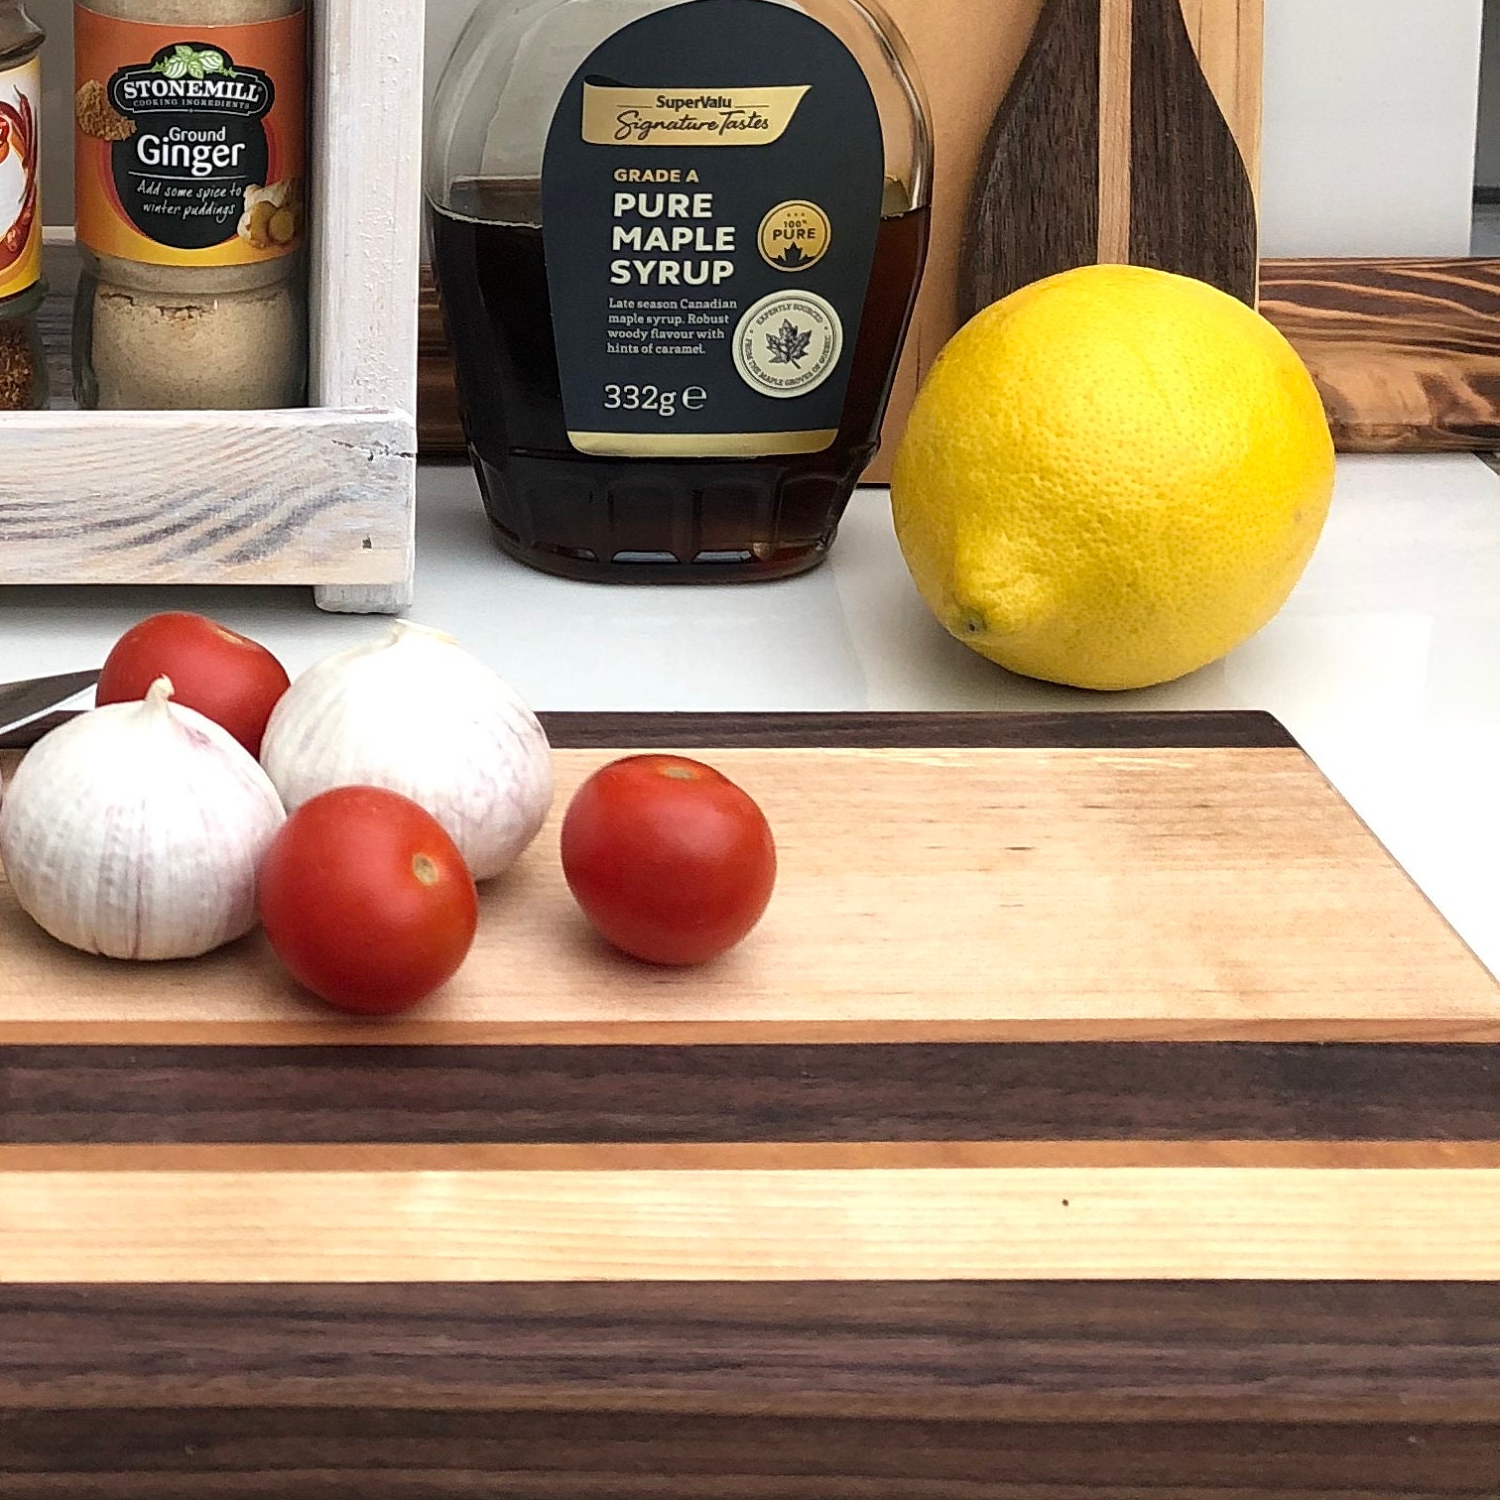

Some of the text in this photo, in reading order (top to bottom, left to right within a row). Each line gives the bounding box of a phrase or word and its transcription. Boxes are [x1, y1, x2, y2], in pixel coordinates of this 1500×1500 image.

[123, 79, 260, 103] STONEMILL
[133, 98, 250, 110] COOKING INGREDIENTS
[655, 94, 732, 112] SuperValu
[168, 125, 226, 142] Ground
[613, 109, 769, 141] Signature Tastes
[137, 134, 246, 177] Ginger
[613, 168, 700, 183] GRADE A
[136, 179, 242, 203] Add some spice to
[142, 201, 236, 224] winter puddings
[613, 192, 714, 218] PURE
[612, 226, 736, 252] MAPLE
[772, 227, 817, 241] PURE
[610, 259, 735, 285] SYRUP
[608, 298, 738, 310] Late season Canadian
[608, 313, 730, 327] maple syrup. Robust
[607, 328, 725, 341] woody flavour with
[606, 342, 706, 354] hints of caramel.
[603, 384, 677, 417] 332g
